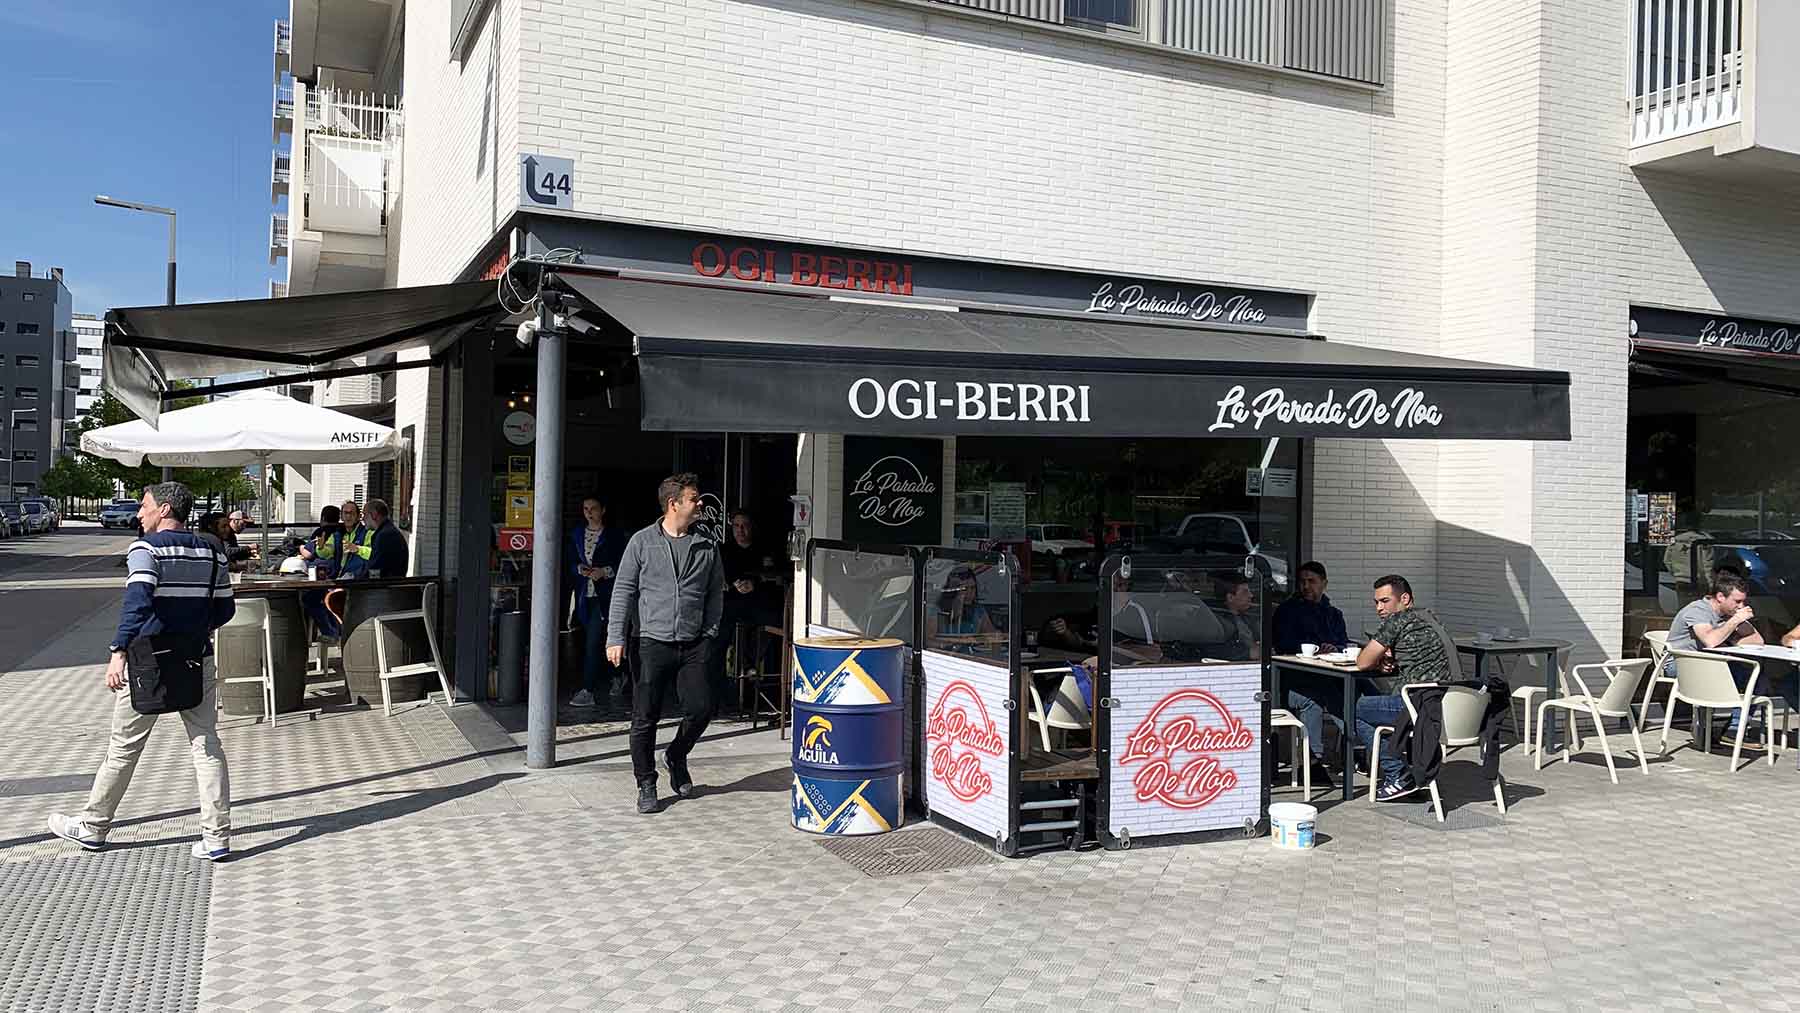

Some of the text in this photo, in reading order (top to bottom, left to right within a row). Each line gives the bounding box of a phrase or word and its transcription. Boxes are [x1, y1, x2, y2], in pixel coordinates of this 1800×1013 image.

[541, 172, 571, 195] 44
[691, 243, 913, 296] OGI BERRI
[1085, 282, 1266, 322] La Parada De Noa
[1696, 319, 1719, 347] La
[1719, 322, 1770, 347] Parada
[1771, 327, 1793, 353] De
[848, 378, 1091, 422] OGI-BERRI
[1208, 385, 1443, 432] La Parada De Noa
[850, 471, 936, 496] La Parada
[859, 496, 925, 519] De Noa
[815, 743, 824, 751] EL
[926, 703, 1002, 756] La Parada
[1120, 716, 1252, 764] La Parada
[932, 744, 992, 793] De Noa
[1135, 757, 1236, 801] De Noa
